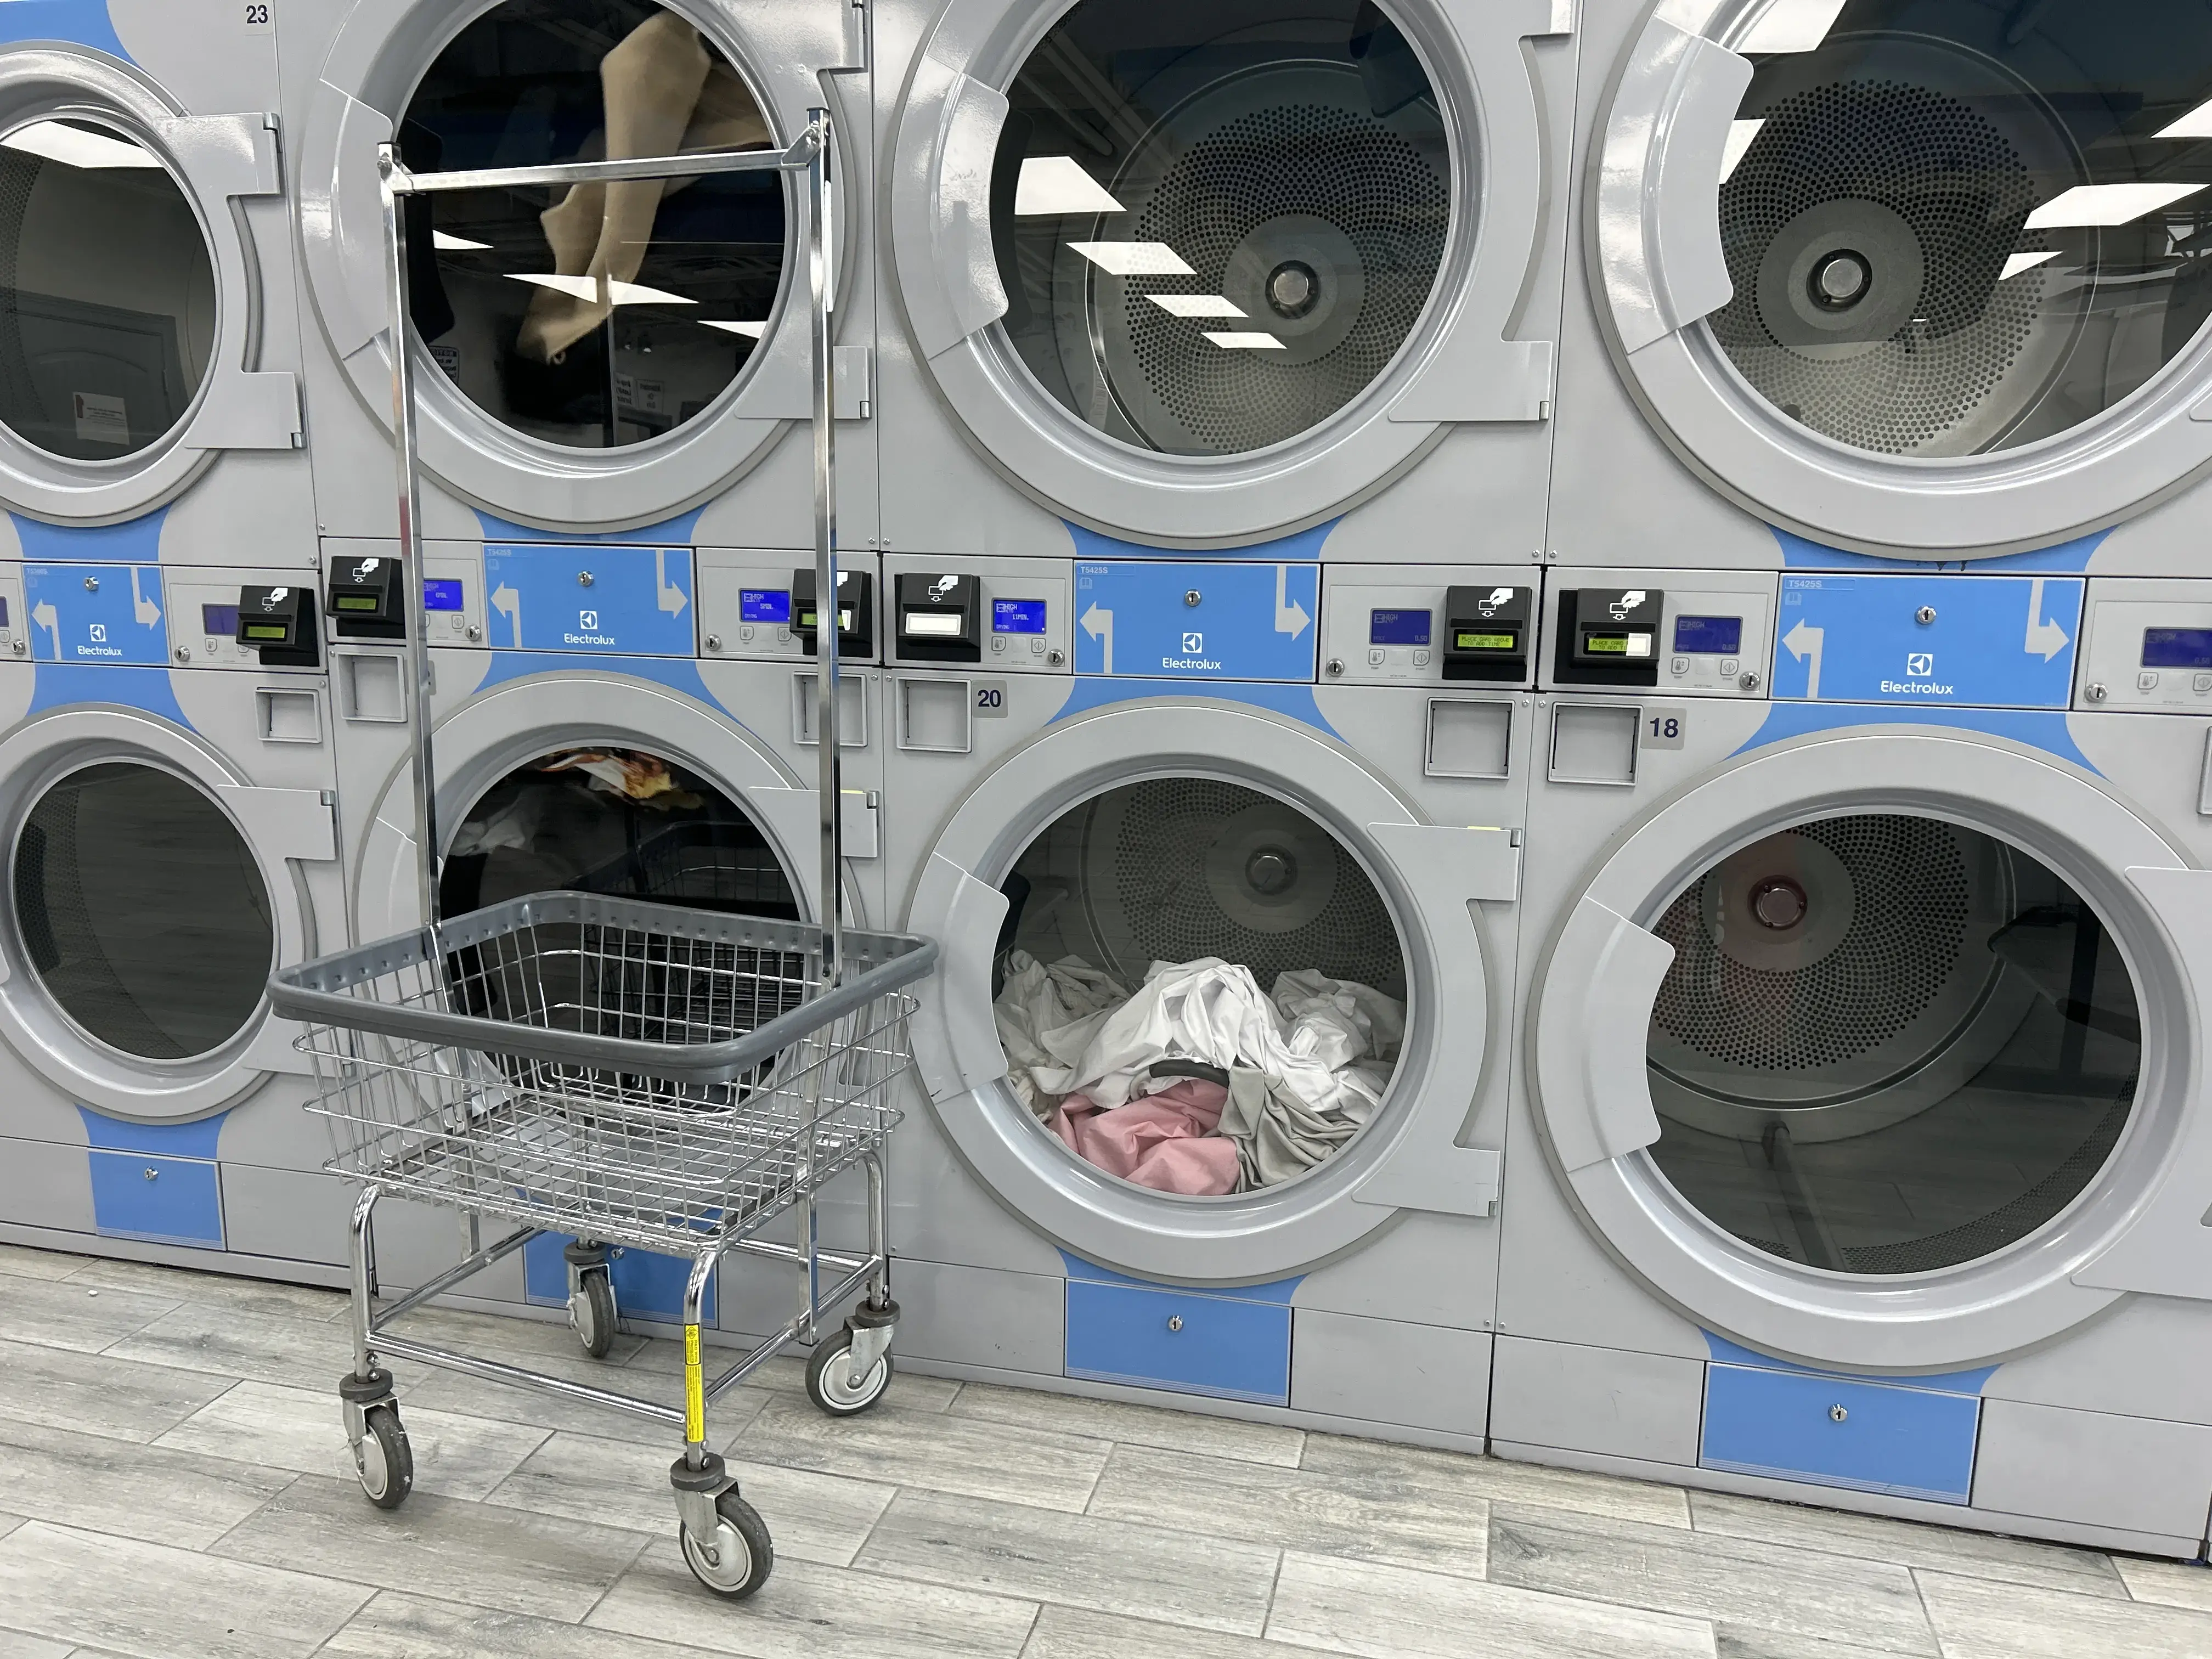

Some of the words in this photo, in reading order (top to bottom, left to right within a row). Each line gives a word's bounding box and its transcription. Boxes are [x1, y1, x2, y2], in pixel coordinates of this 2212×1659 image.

[246, 4, 268, 24] 23
[1788, 579, 1822, 589] T5425S
[564, 633, 615, 645] Electrolux
[77, 645, 122, 656] Electrolux
[1162, 657, 1221, 670] Electrolux
[1881, 680, 1953, 695] Electrolux
[978, 690, 1002, 708] 20
[1650, 718, 1679, 738] 18
